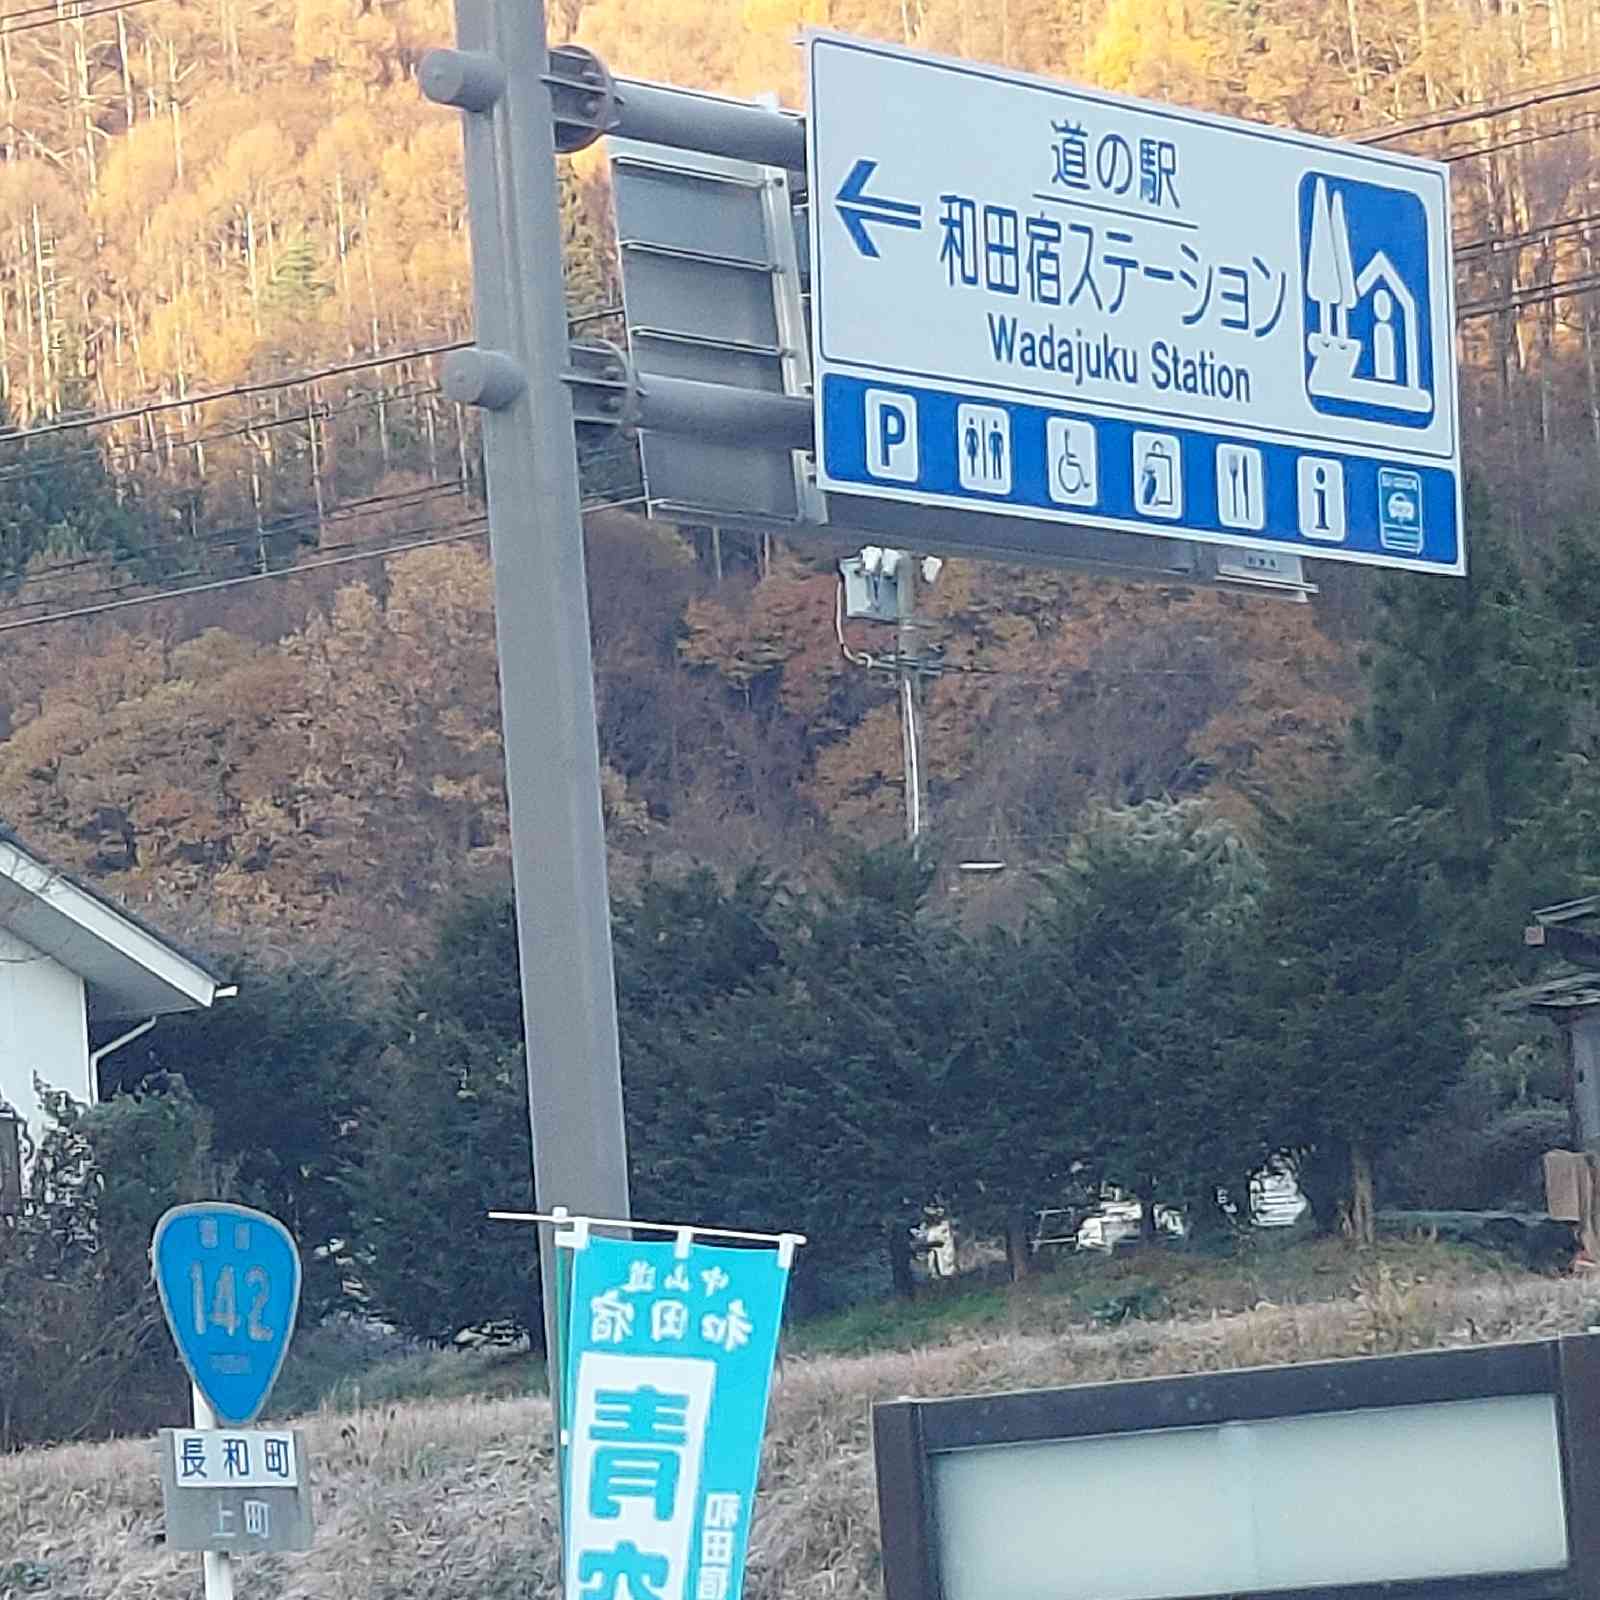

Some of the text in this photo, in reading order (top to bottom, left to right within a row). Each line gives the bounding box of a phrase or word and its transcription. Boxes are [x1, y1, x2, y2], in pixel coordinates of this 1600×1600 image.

[1051, 119, 1181, 209] 道の駅
[939, 194, 1287, 338] 和田宿ステーション
[988, 312, 1251, 403] Wadajuku Station
[189, 1262, 273, 1342] 142
[180, 1437, 290, 1479] 長和町
[211, 1500, 270, 1540] 上町
